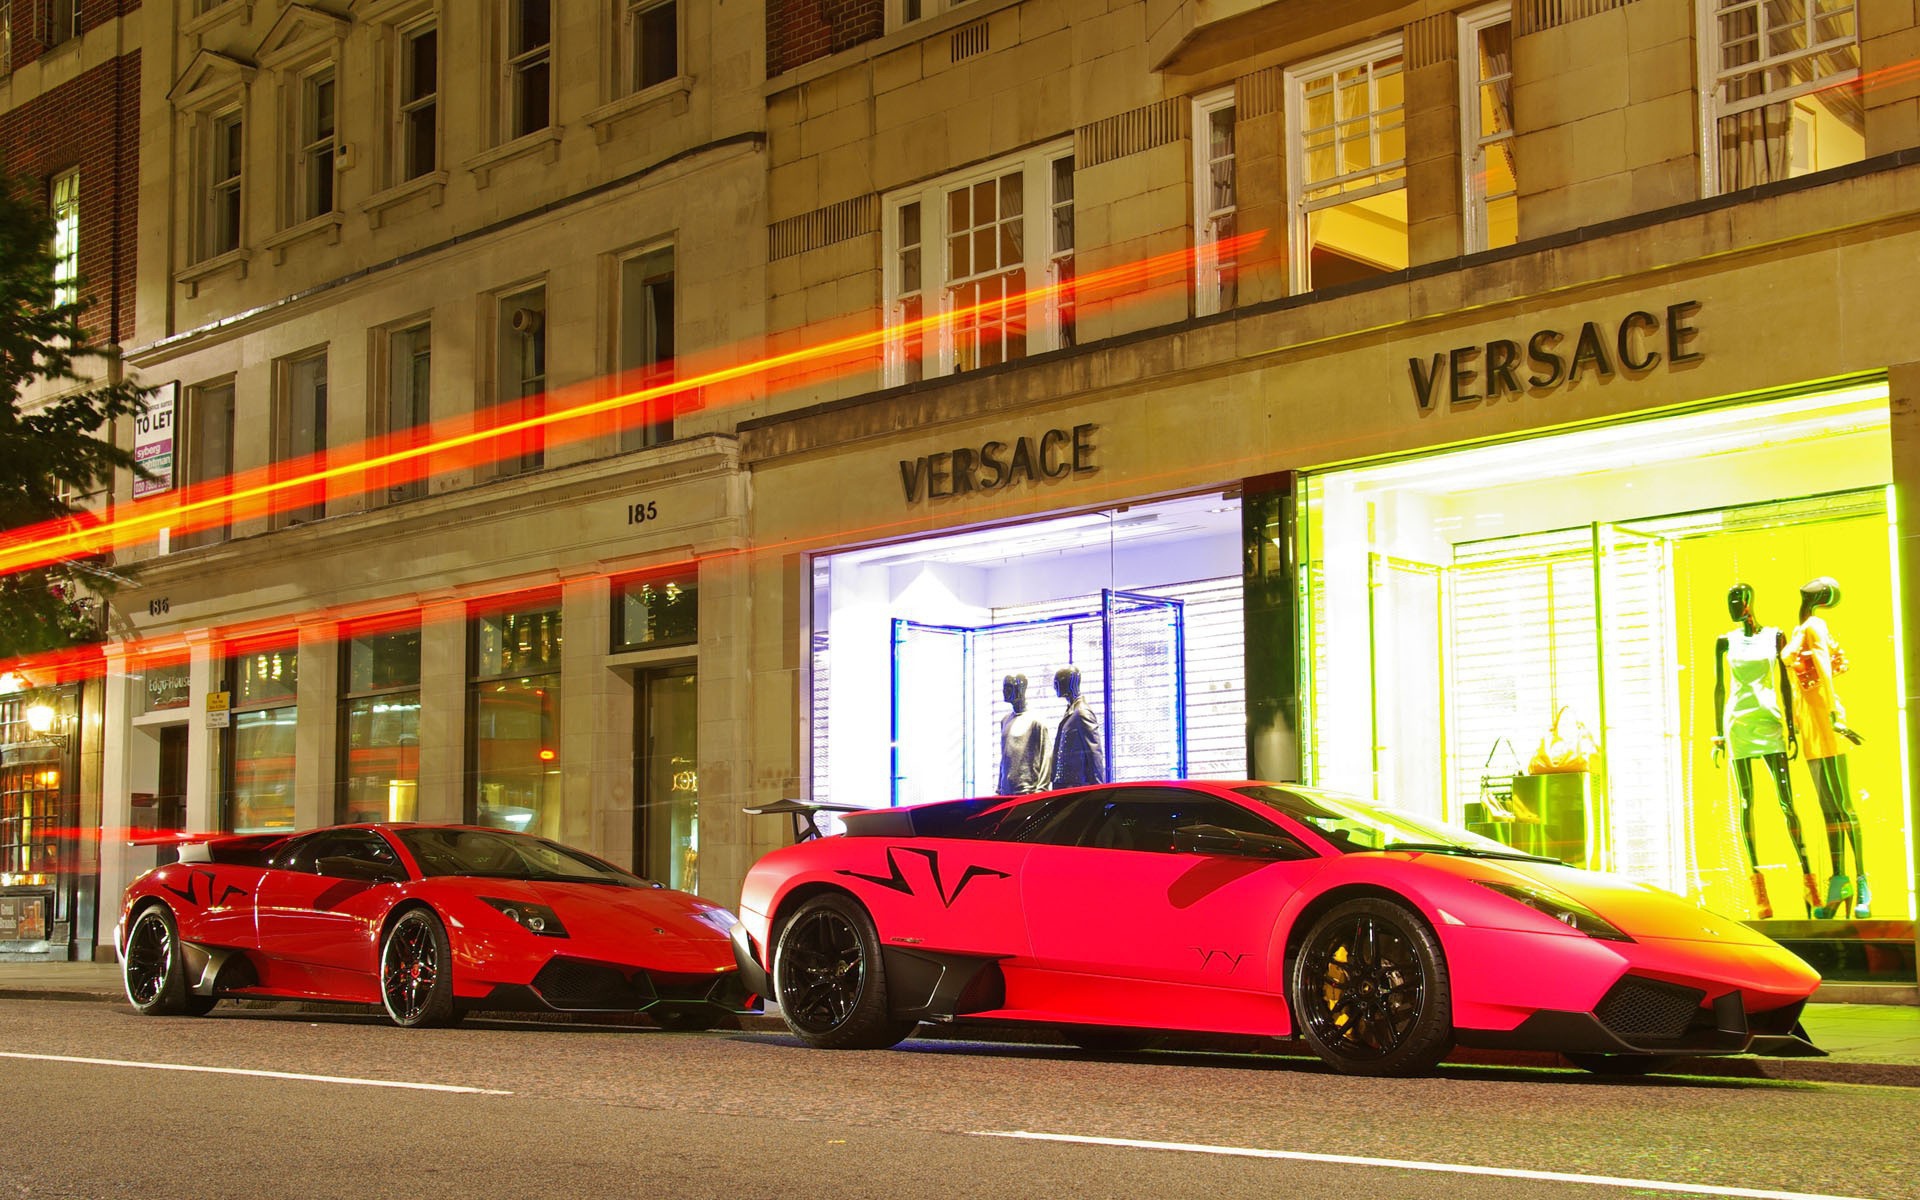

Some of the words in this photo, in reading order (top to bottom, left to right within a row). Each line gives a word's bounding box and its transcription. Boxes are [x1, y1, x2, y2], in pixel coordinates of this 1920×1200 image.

[1408, 300, 1705, 412] VERSACE
[136, 416, 150, 435] TO
[153, 409, 173, 430] LET
[899, 422, 1099, 504] VERSACE
[628, 500, 658, 525] 185
[149, 597, 170, 616] 186
